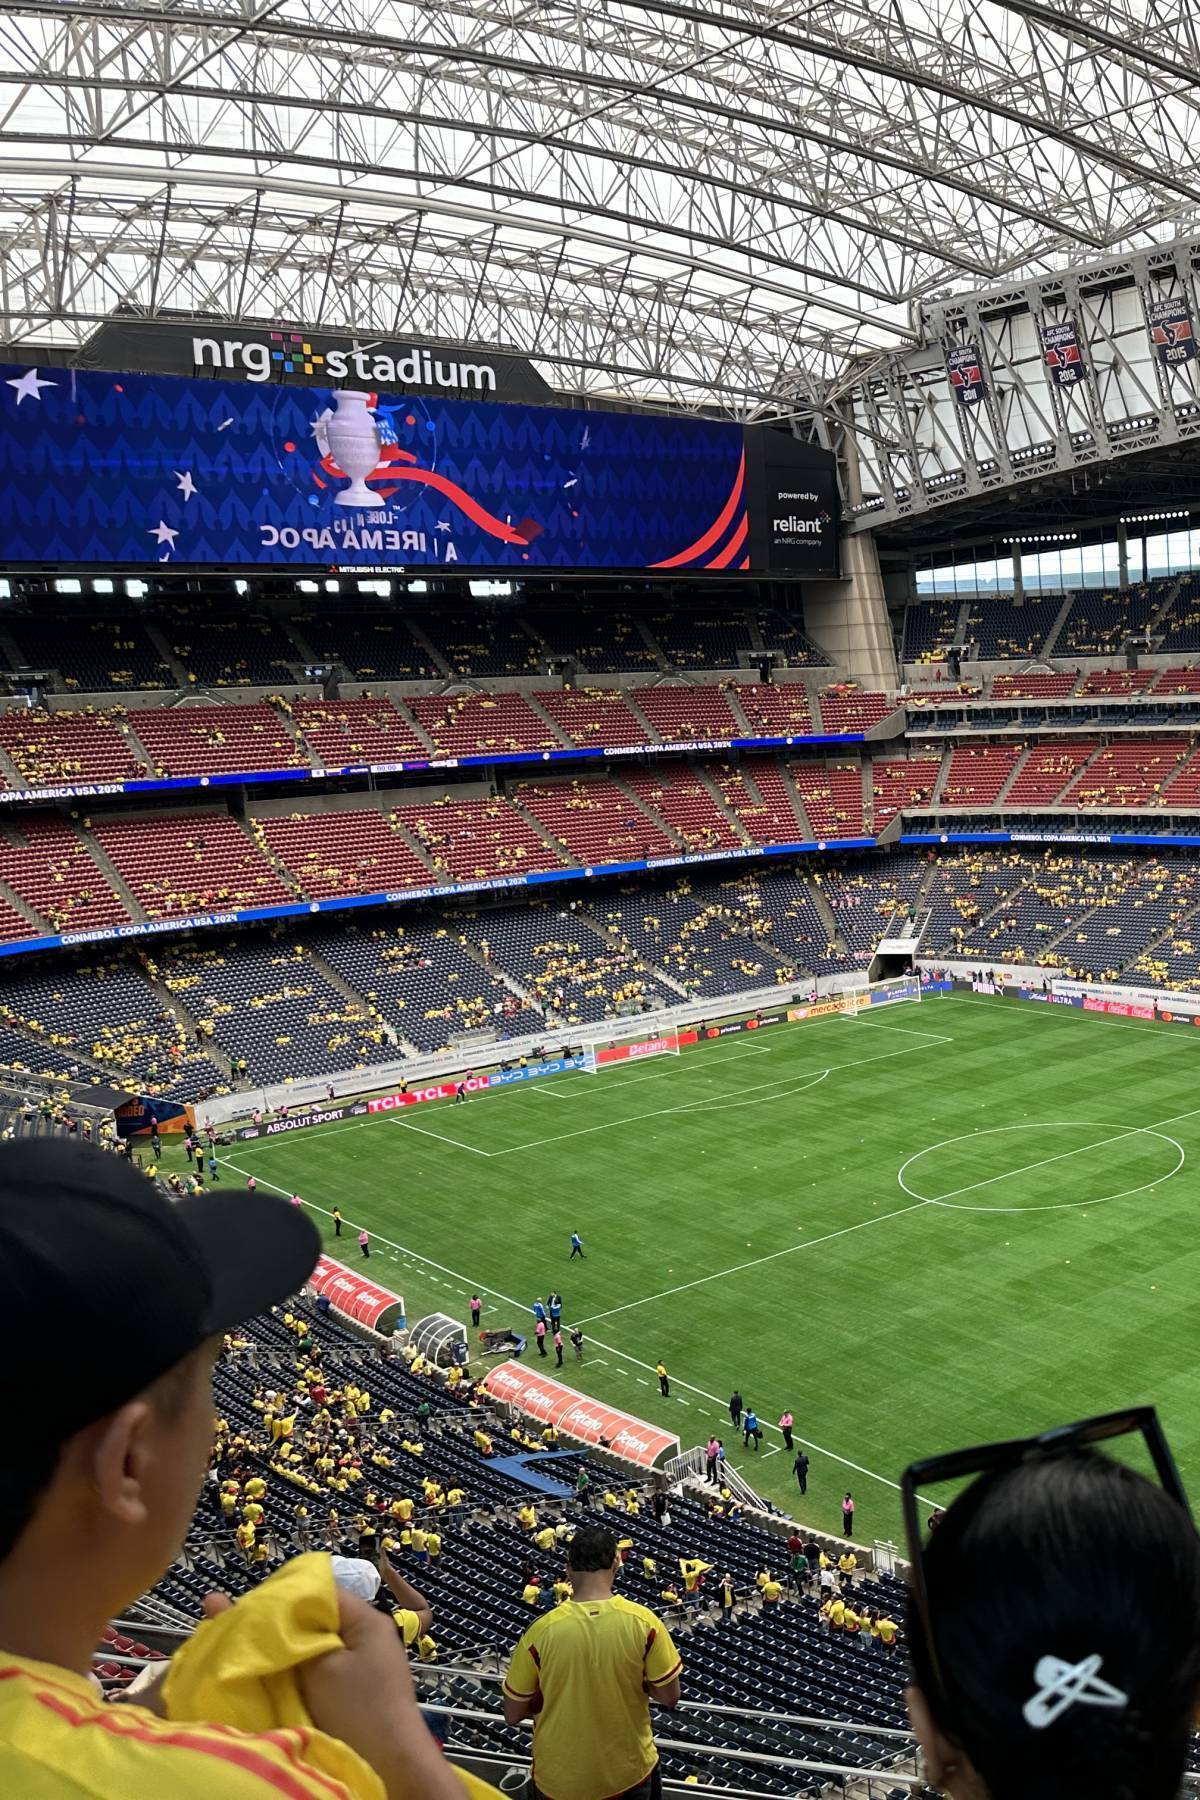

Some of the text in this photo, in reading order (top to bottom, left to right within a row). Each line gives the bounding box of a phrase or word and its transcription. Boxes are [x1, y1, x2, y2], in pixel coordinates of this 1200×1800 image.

[1164, 301, 1181, 309] SOUTH
[1151, 307, 1186, 321] CHAMPIONS
[1045, 331, 1074, 344] CHAMPIONS
[1055, 325, 1070, 334] SOUTH
[1165, 346, 1187, 361] 2015
[193, 337, 496, 391] nrg stadium
[1058, 368, 1077, 382] 2012
[778, 492, 819, 502] powered by
[773, 516, 822, 533] reliant
[782, 537, 795, 545] NRG
[796, 539, 822, 547] company
[604, 746, 643, 755] CONMEBOL
[645, 744, 664, 753] COPA
[664, 743, 697, 751] AMERICA
[24, 787, 75, 800] AMERICA
[76, 785, 97, 795] USA
[97, 784, 124, 794] 2024
[646, 858, 685, 868] CONMEBOL
[685, 856, 703, 864] COPA
[703, 851, 732, 861] AMERICA
[386, 877, 527, 901] CONMEBOL COPA AMERICA USA 2024
[61, 914, 238, 944] CONMEBOL COPA AMERICA USA 2024
[810, 999, 847, 1015] mercado
[1053, 995, 1073, 1005] ULTRA
[413, 1087, 448, 1102] TCL
[369, 1096, 406, 1112] TCL
[267, 1109, 344, 1134] ABSOLUT SPORT
[524, 1388, 554, 1408] Betano
[570, 1409, 603, 1431] Betano
[617, 1430, 649, 1453] Betano
